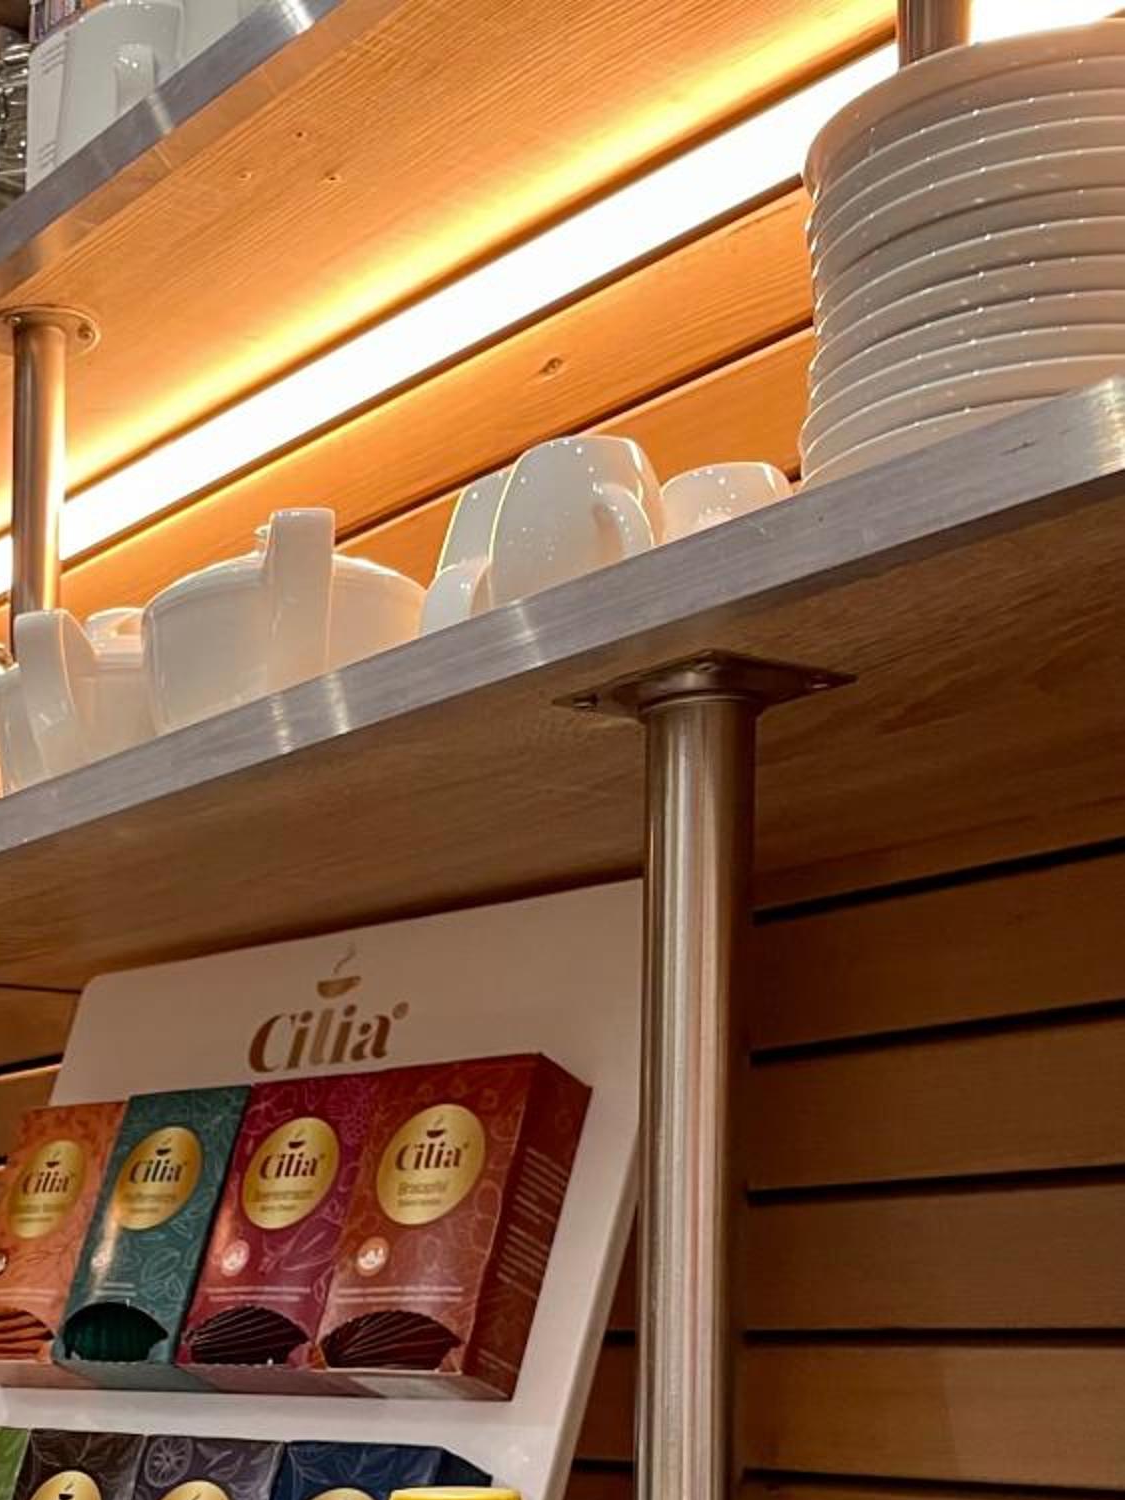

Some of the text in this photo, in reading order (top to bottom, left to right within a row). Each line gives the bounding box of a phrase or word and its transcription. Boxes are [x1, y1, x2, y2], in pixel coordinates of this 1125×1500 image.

[249, 1004, 391, 1073] Cilia
[260, 1151, 319, 1179] Cilia
[396, 1141, 462, 1171] Cilia
[22, 1171, 70, 1194] Cilia
[129, 1159, 182, 1183] Cilia
